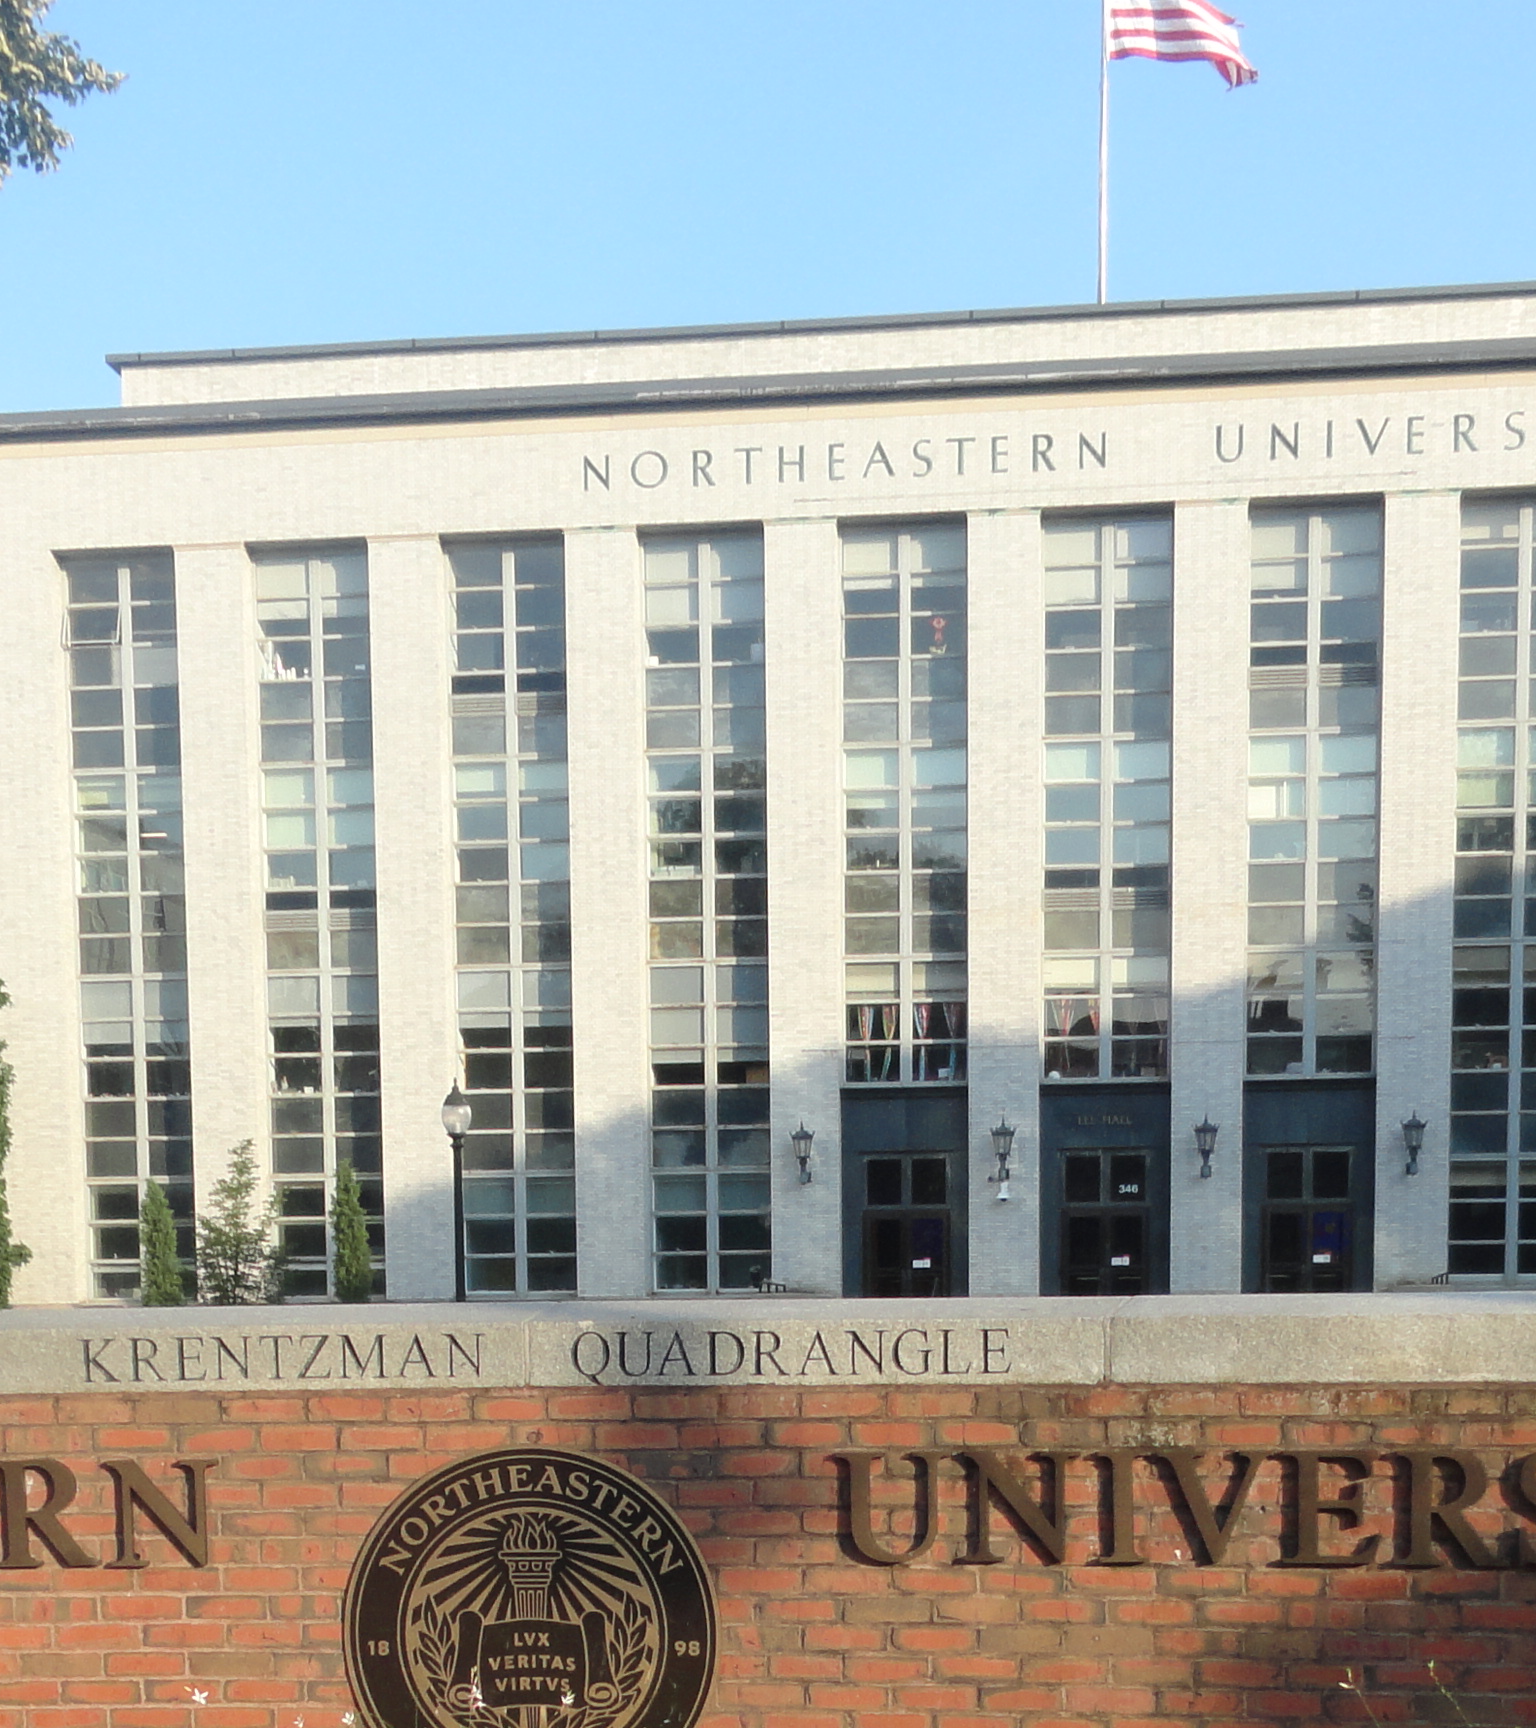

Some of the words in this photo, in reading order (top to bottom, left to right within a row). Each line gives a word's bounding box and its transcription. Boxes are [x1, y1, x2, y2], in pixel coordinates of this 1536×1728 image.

[582, 431, 1108, 492] NORTHEASTERN
[1118, 1184, 1139, 1194] 346
[79, 1332, 485, 1384] KRENTZMAN
[571, 1326, 1013, 1387] QUADRANGLE
[378, 1464, 684, 1577] NORTHEASTERN
[367, 1640, 390, 1656] 18
[514, 1631, 551, 1648] LVX
[674, 1640, 701, 1657] 98
[487, 1654, 577, 1672] VERITAS
[495, 1676, 571, 1692] VIRTVS
